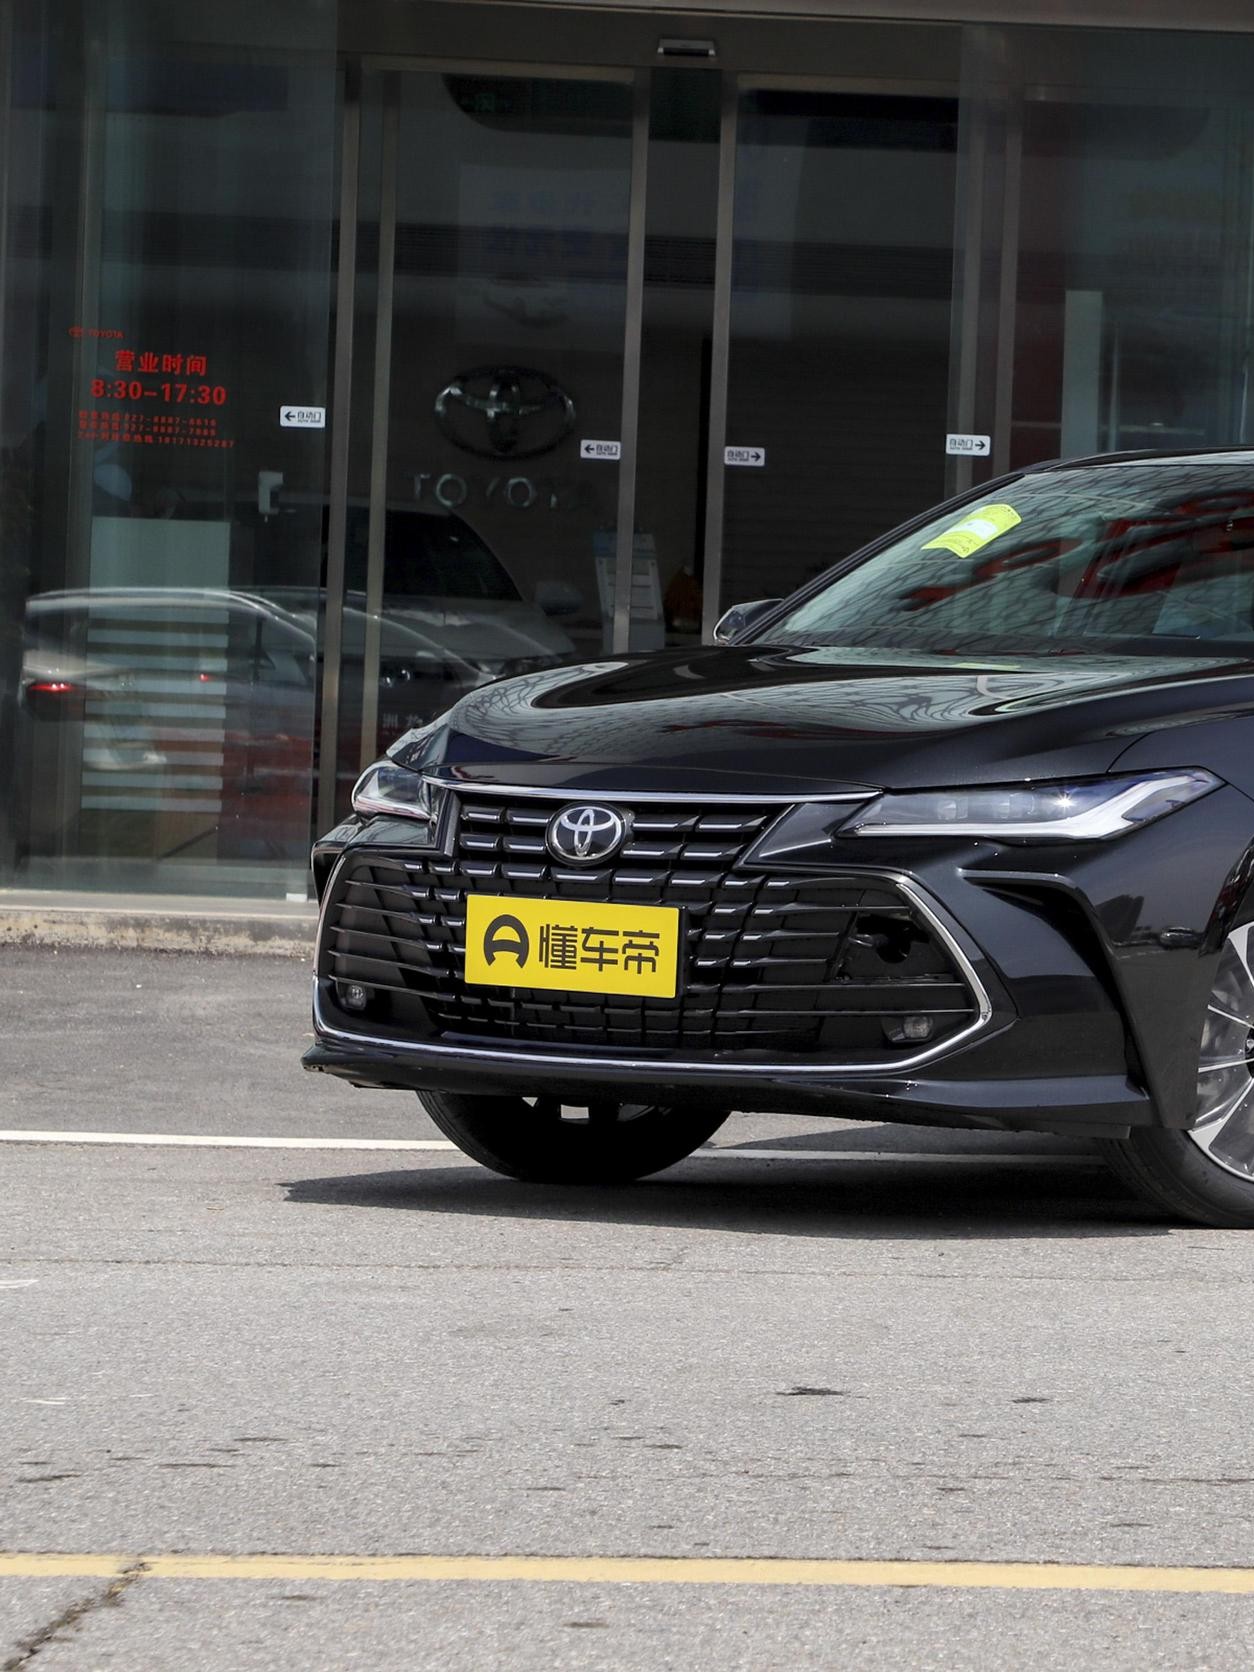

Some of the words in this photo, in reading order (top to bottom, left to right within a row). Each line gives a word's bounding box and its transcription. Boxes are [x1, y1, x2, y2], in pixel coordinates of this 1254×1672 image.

[114, 350, 208, 377] 营业时间
[539, 923, 660, 974] 懂车帝
